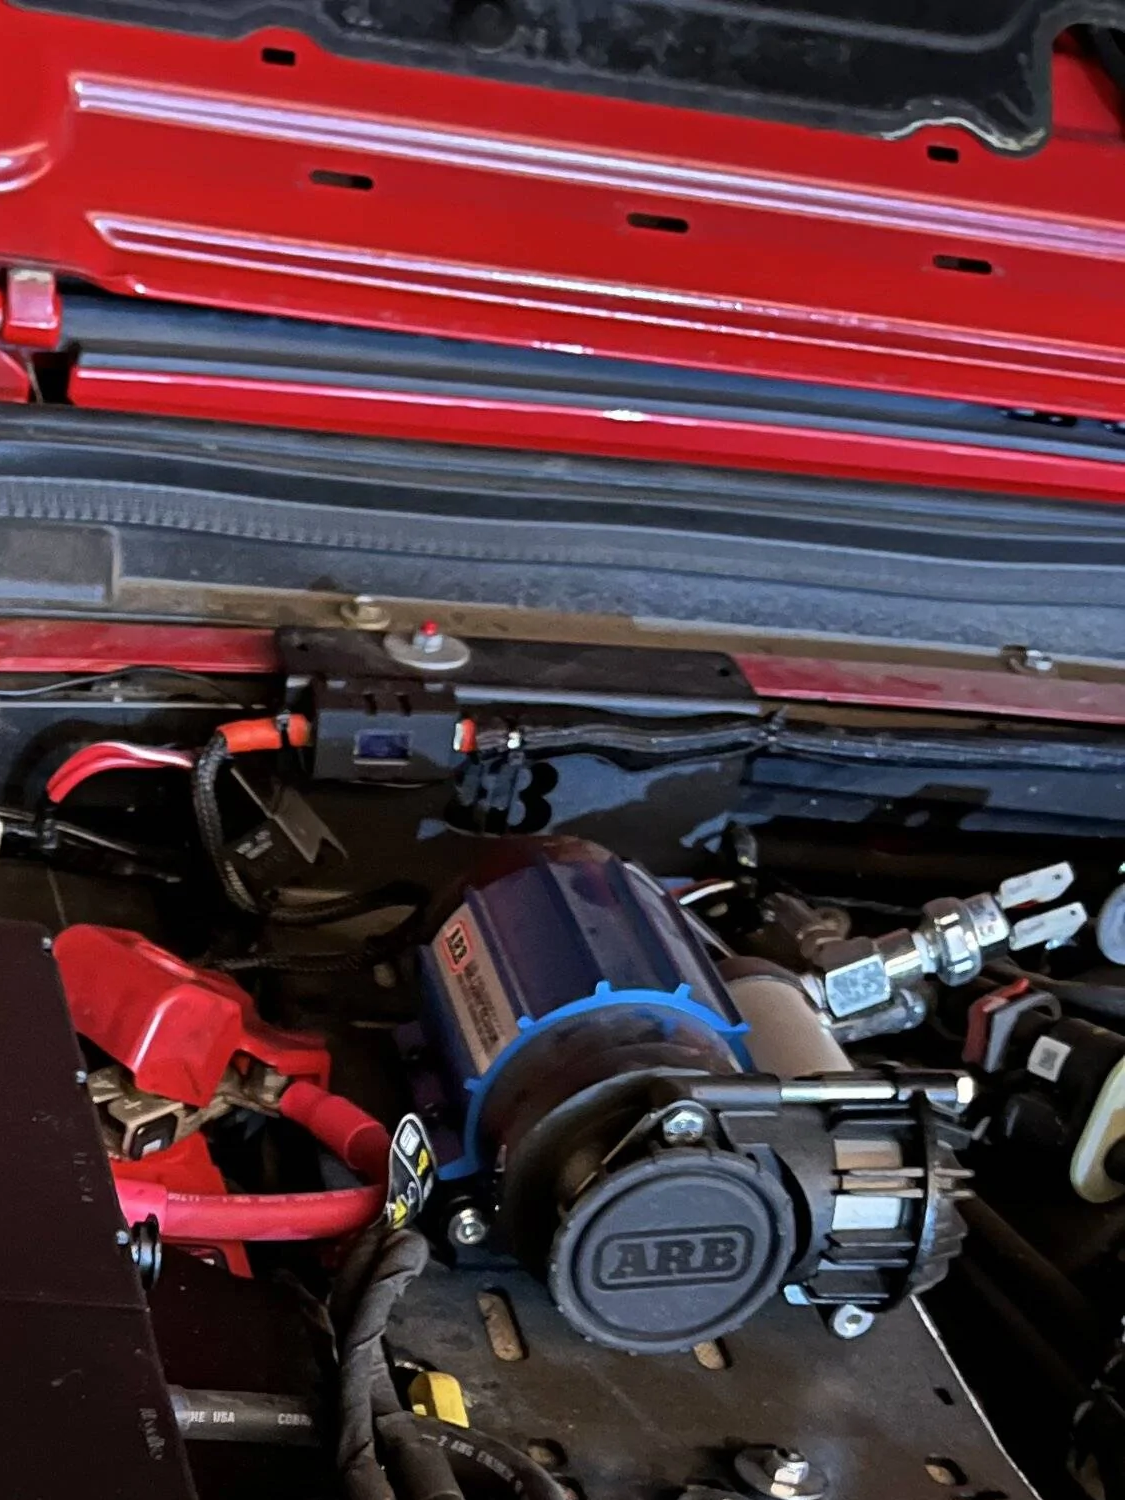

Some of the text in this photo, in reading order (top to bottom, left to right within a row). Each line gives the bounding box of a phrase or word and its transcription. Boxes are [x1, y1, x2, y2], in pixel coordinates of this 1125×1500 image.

[446, 926, 468, 966] ARB
[608, 1237, 738, 1279] ARB
[213, 1411, 236, 1423] USA
